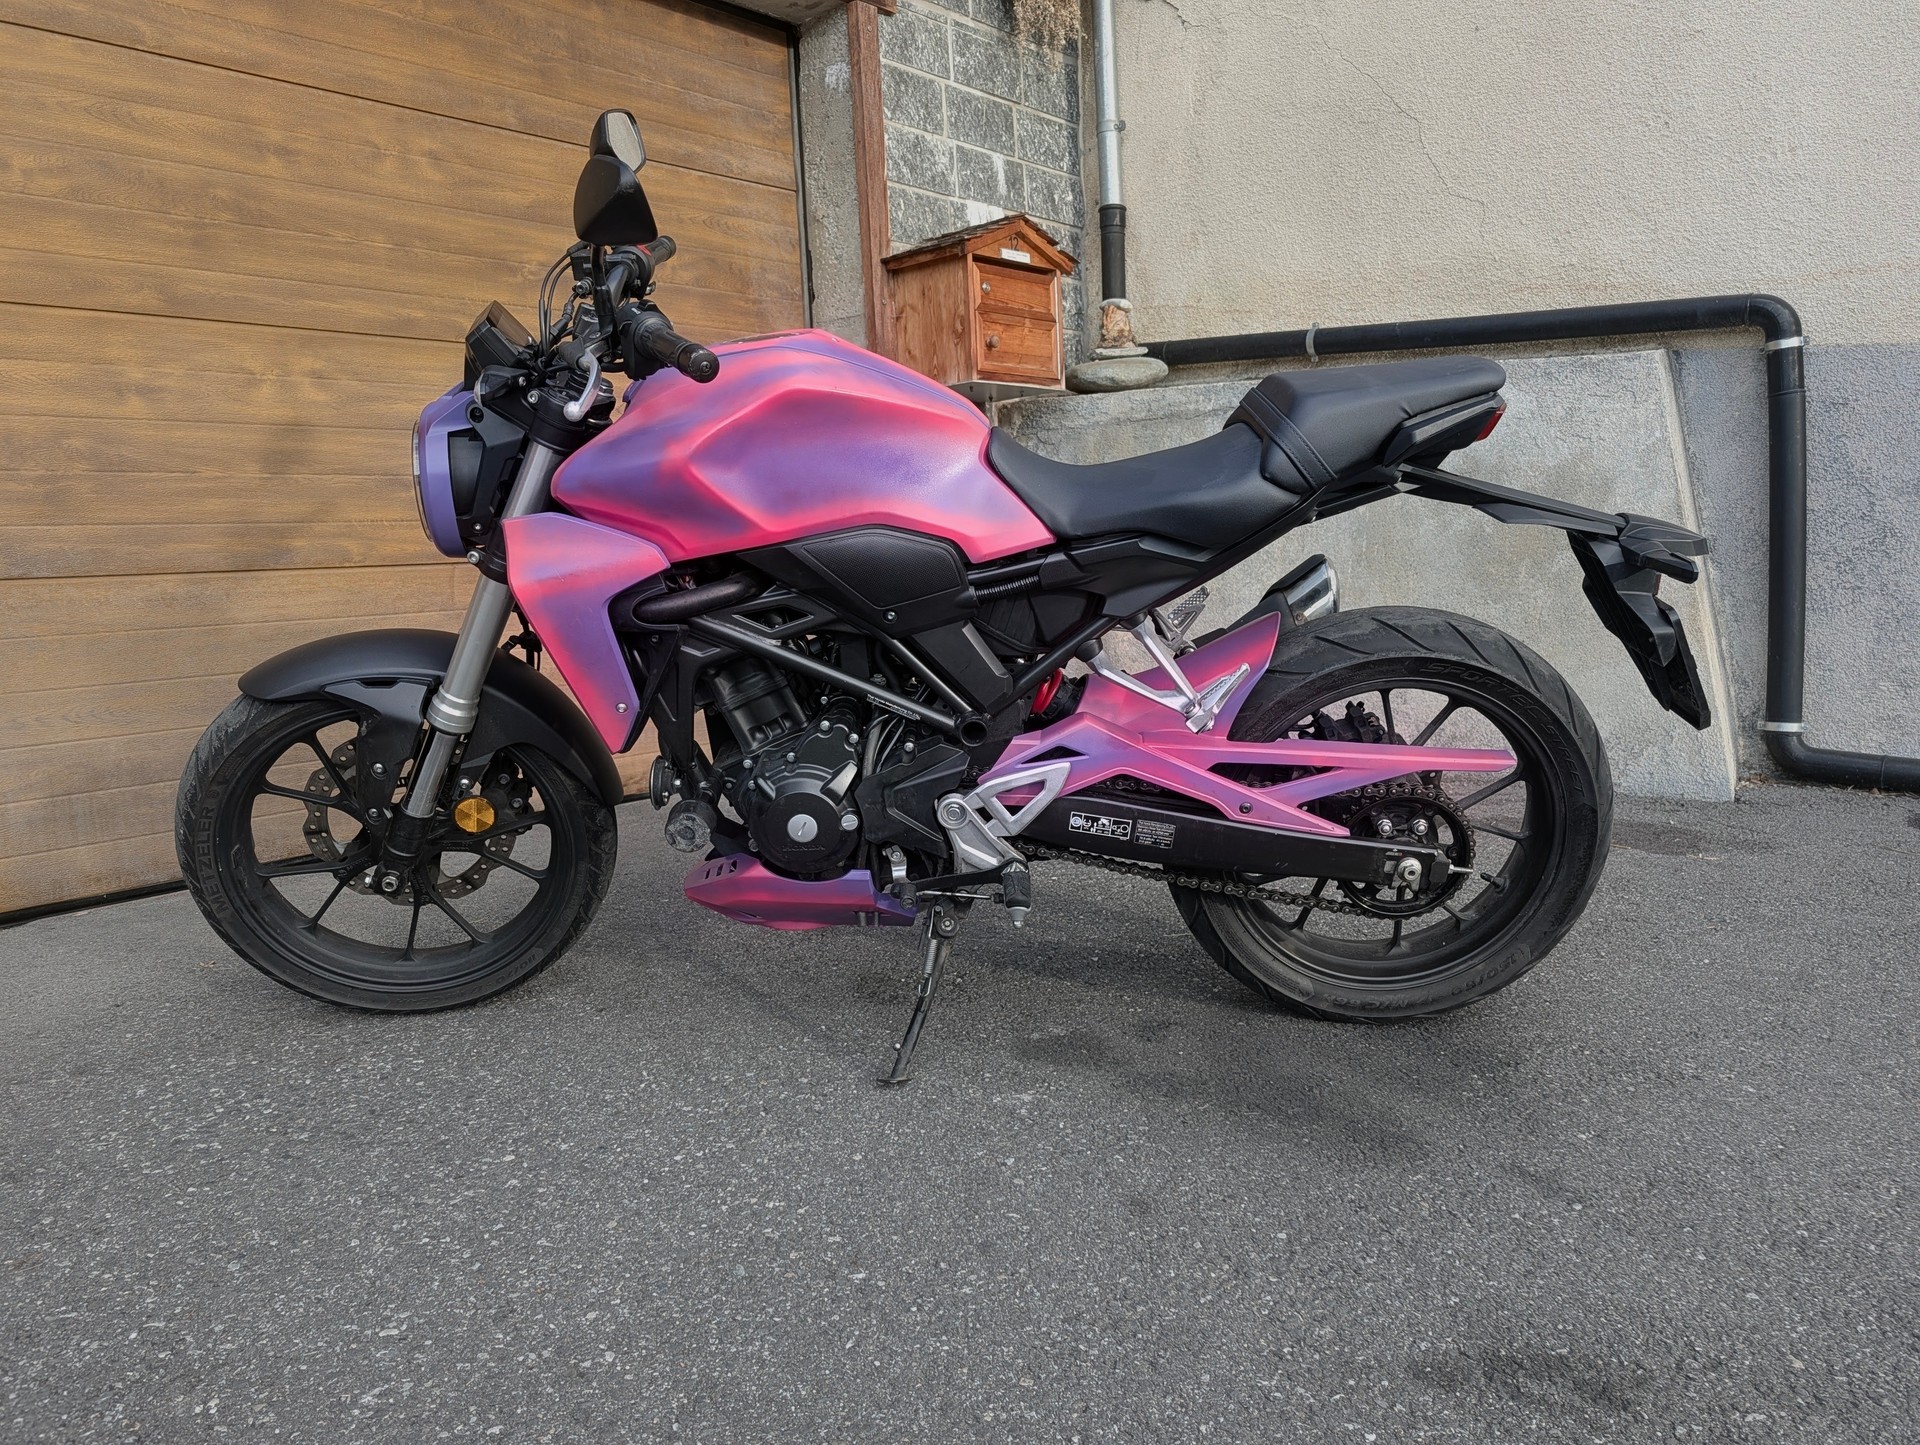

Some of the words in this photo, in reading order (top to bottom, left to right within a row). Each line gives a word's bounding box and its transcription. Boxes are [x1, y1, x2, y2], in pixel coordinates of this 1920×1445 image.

[1008, 235, 1020, 251] 12
[1420, 662, 1552, 722] SPORTEC
[1541, 724, 1586, 798] STREET
[197, 805, 229, 915] METZELER
[782, 844, 826, 852] HONDA
